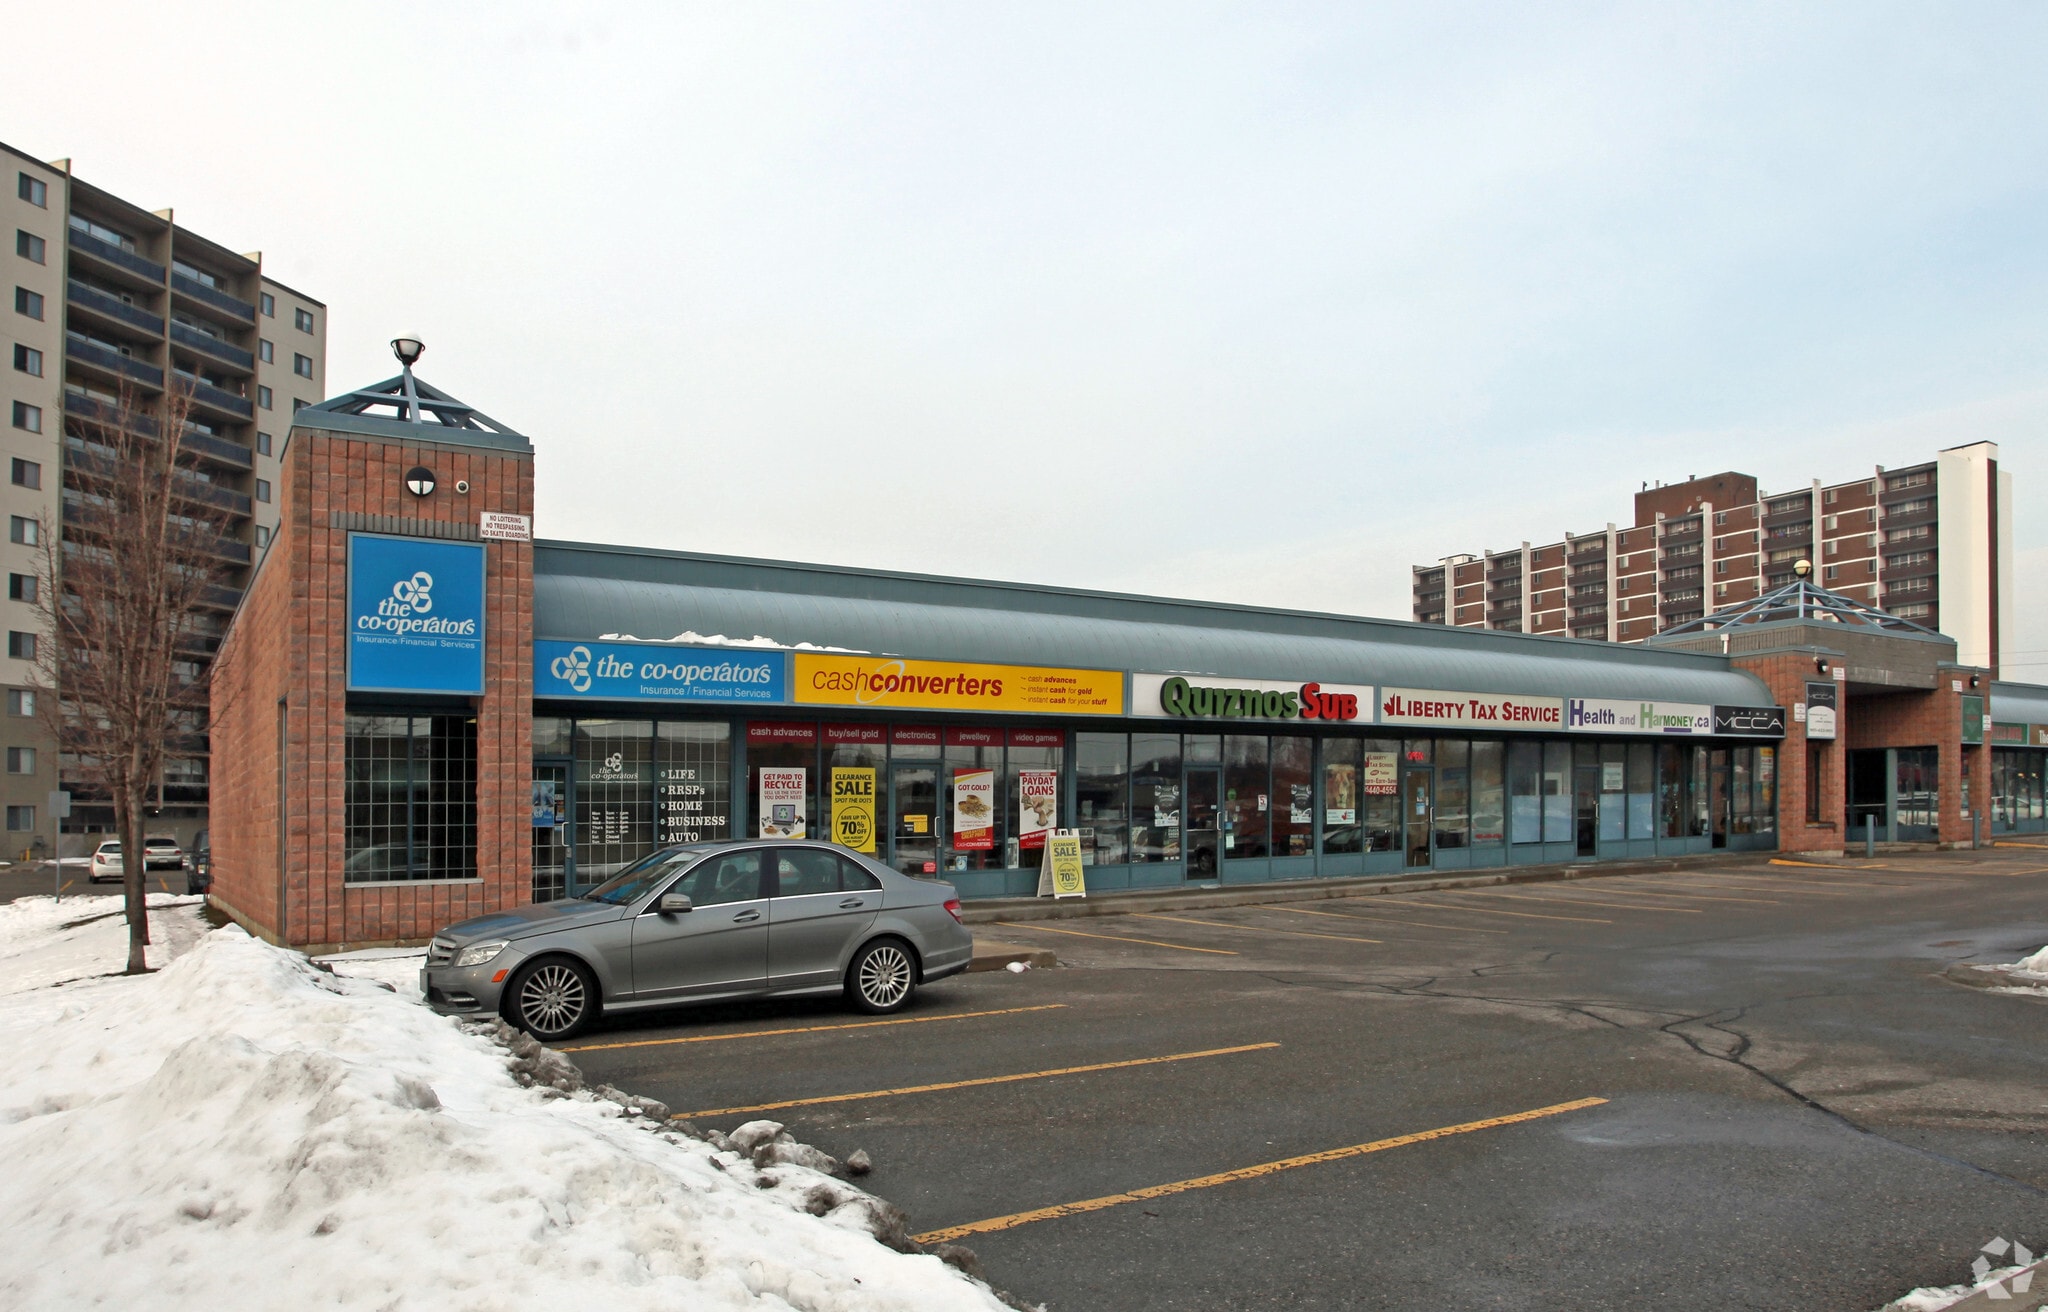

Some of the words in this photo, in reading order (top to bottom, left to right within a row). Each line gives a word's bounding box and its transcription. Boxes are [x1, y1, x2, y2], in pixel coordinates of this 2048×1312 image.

[494, 523, 525, 531] TRESPASSING
[378, 597, 411, 616] the
[358, 615, 475, 635] co-operators
[440, 640, 475, 649] Services
[596, 654, 633, 678] the
[640, 662, 771, 685] co-operators
[640, 685, 684, 695] Insurance
[693, 686, 732, 697] Financial
[735, 688, 771, 698] Services
[1396, 696, 1464, 719] LIBERTY
[1469, 700, 1497, 720] TAX
[1502, 702, 1559, 722] SERVICE
[1570, 700, 1615, 726] Health
[1619, 715, 1635, 725] and
[1715, 716, 1783, 730] MCCA
[750, 728, 771, 736] cash
[774, 728, 812, 737] advances
[828, 729, 859, 738] buy/sell
[862, 730, 879, 740] gold
[896, 731, 936, 739] electronics
[959, 732, 991, 742] jewellery
[1035, 735, 1057, 743] games
[1407, 752, 1424, 760] OPEN
[668, 770, 695, 779] LIFE
[1022, 777, 1054, 785] PAYDAY
[668, 786, 705, 795] RRSPs
[835, 781, 872, 795] SALE
[1022, 786, 1054, 795] LOANS
[668, 801, 702, 810] HOME
[668, 816, 725, 826] BUSINESS
[668, 832, 698, 842] AUTO
[1054, 847, 1077, 856] SALE
